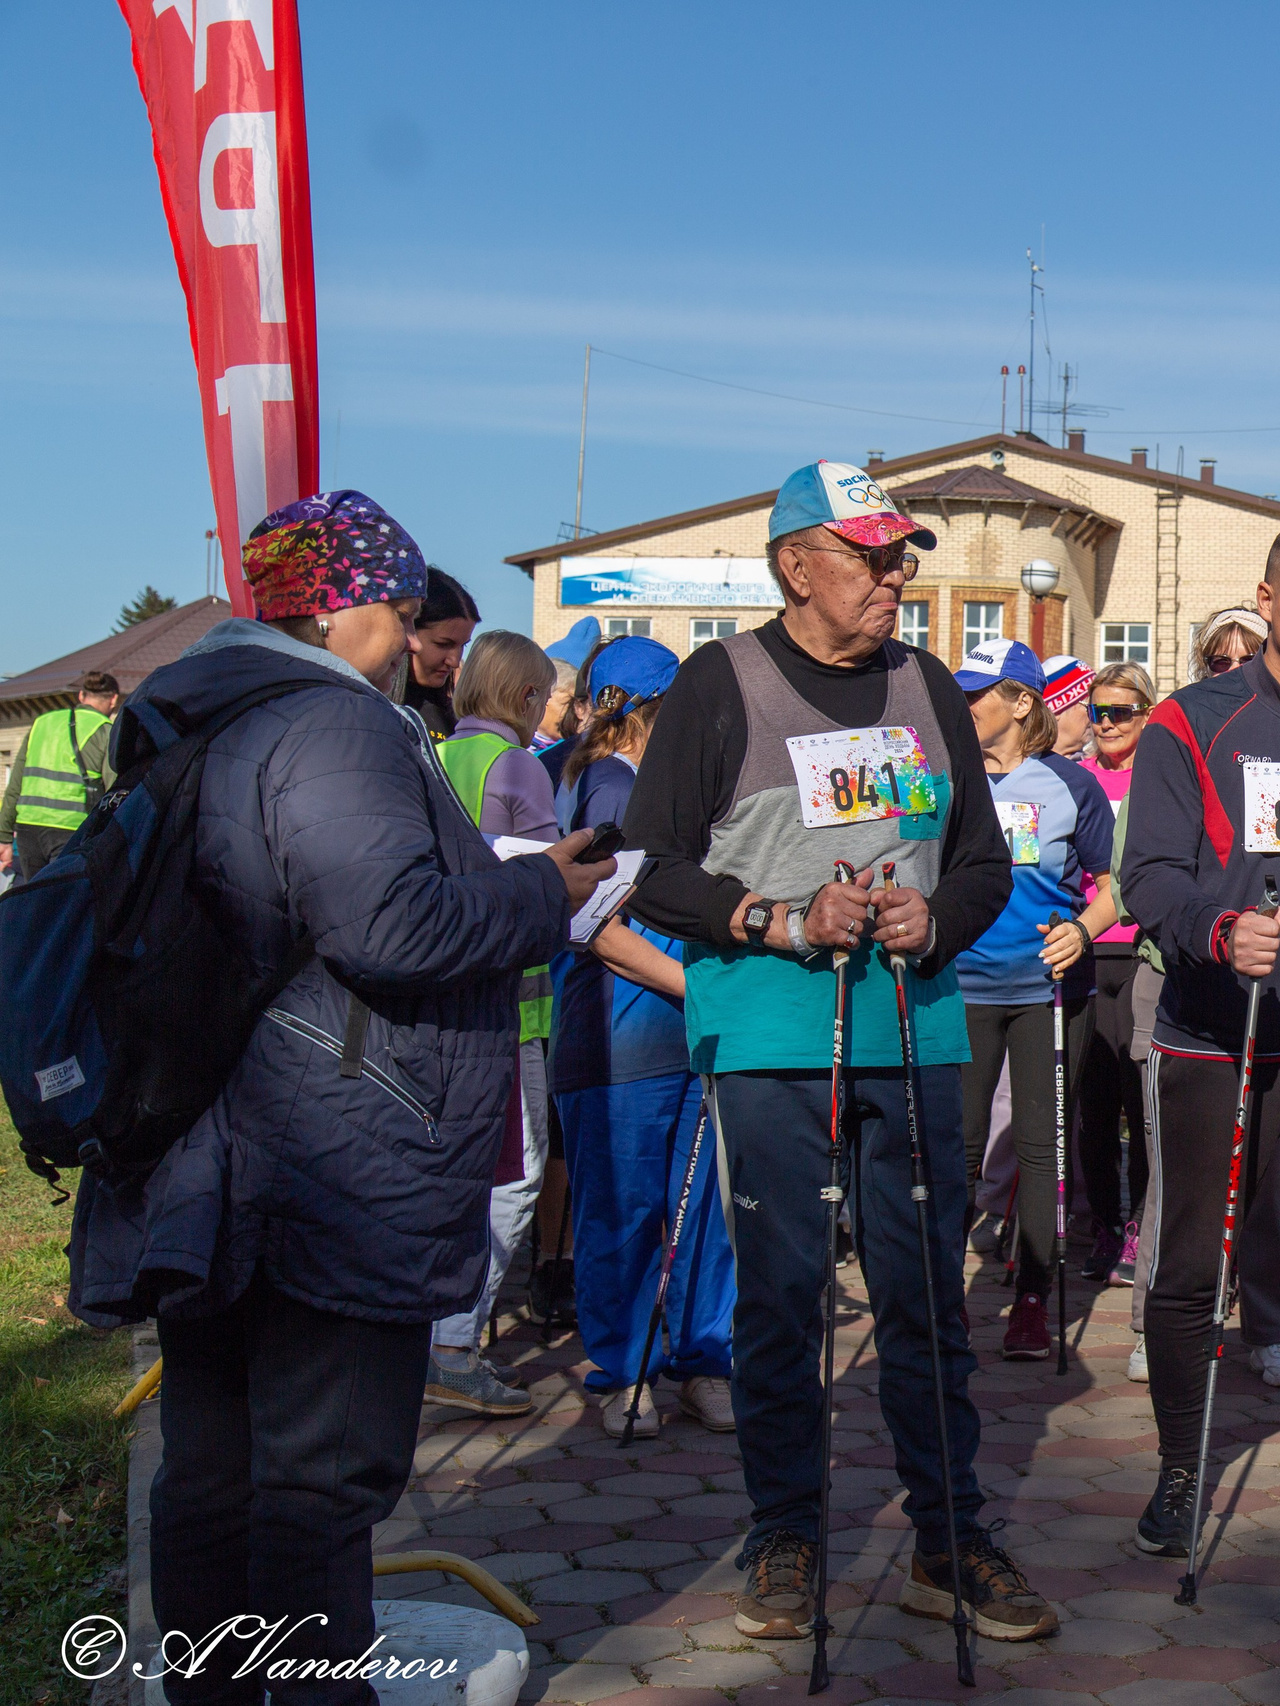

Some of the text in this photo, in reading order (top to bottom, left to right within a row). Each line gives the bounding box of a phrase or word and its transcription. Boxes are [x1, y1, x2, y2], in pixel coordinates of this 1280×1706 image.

[836, 475, 869, 488] SOCHI
[829, 761, 901, 812] 841
[833, 1018, 843, 1065] LEKI
[1055, 1064, 1065, 1126] СЕВЕРНАЯ
